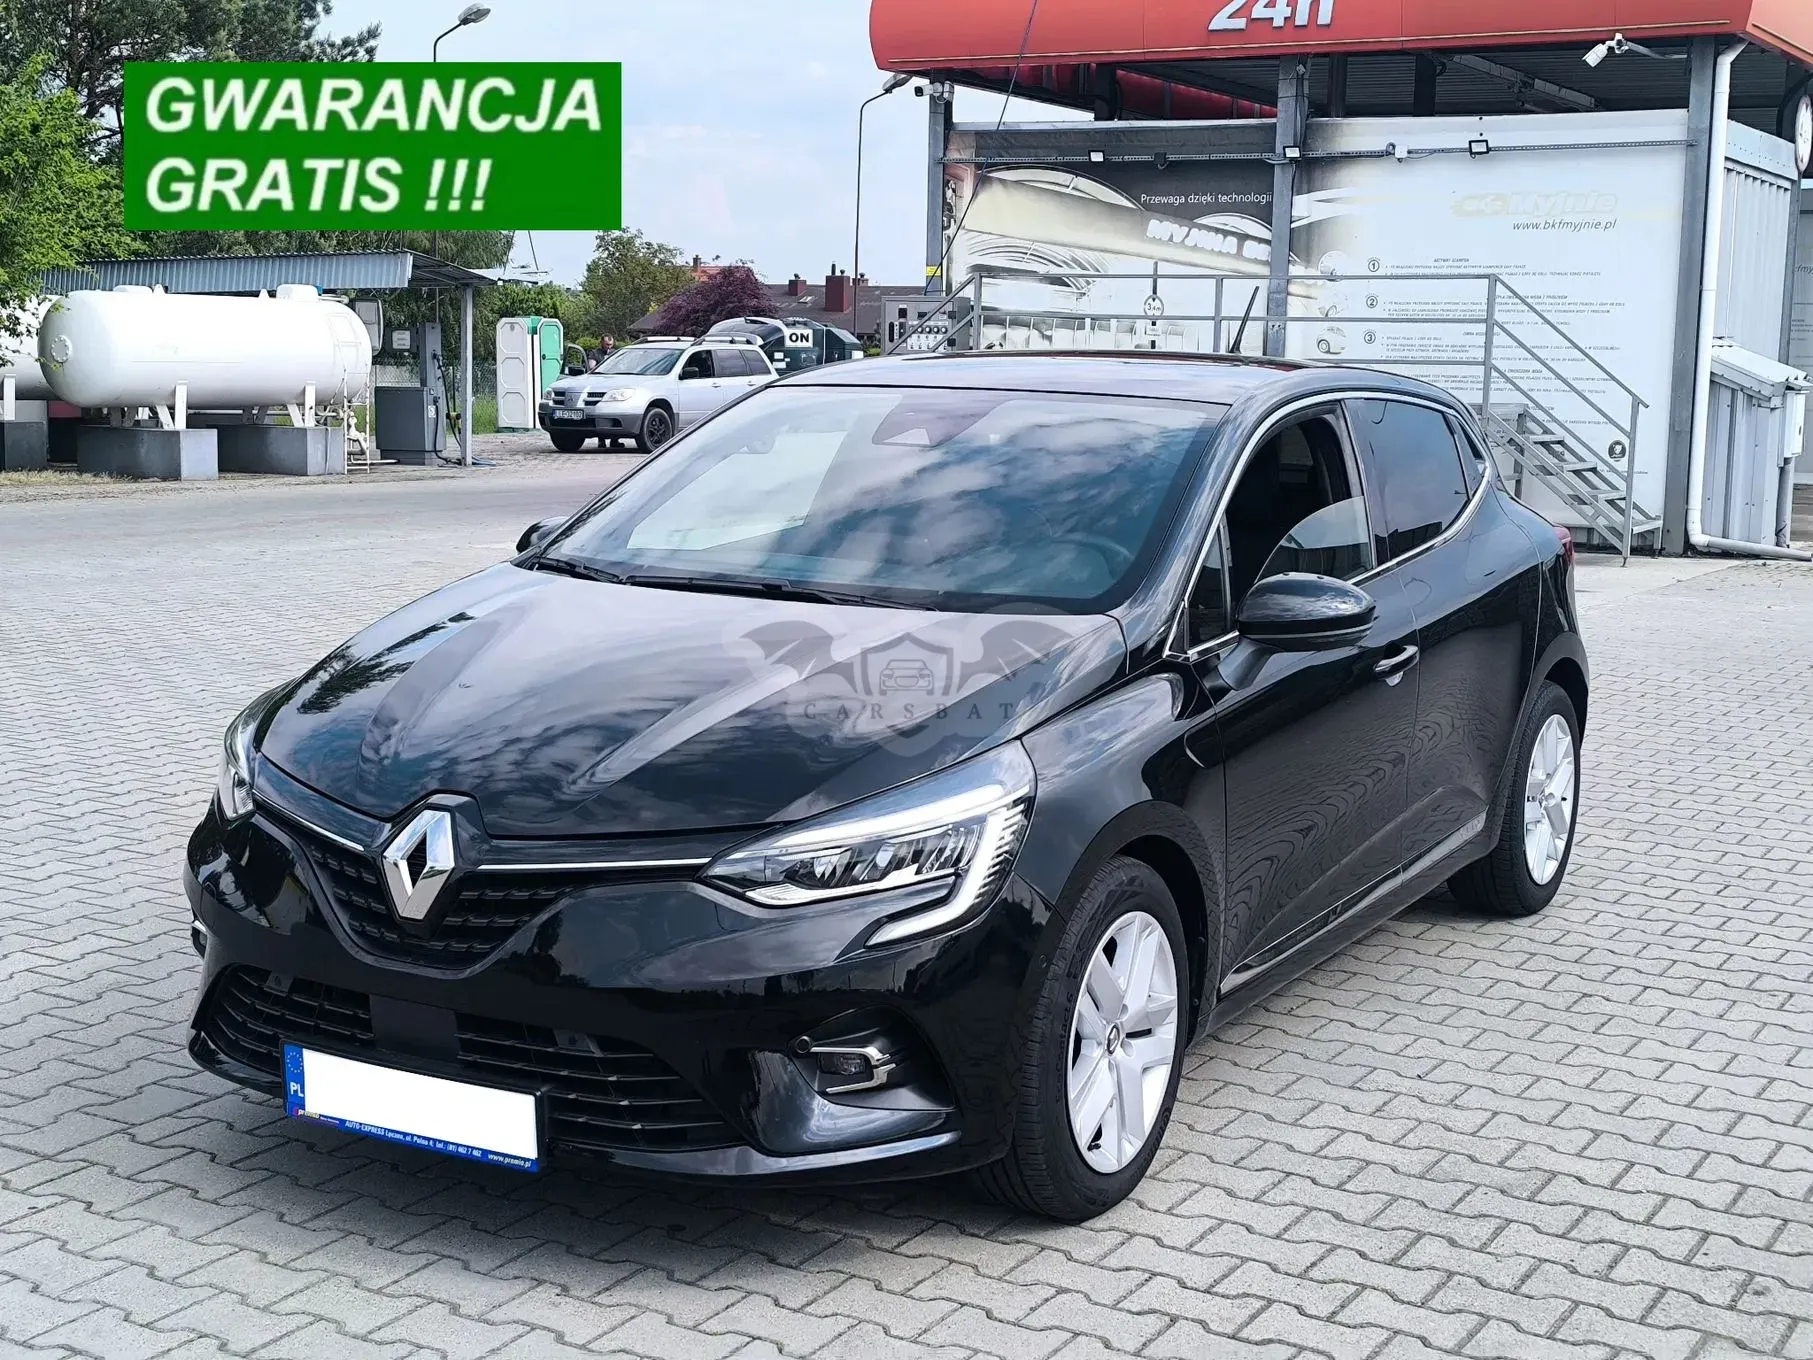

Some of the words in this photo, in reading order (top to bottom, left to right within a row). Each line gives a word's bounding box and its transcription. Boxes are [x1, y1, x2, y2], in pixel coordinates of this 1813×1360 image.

[1141, 194, 1185, 206] Przewaga
[1188, 192, 1216, 205] dzięki
[1218, 191, 1272, 204] technologii
[1512, 218, 1618, 233] www.bkfmyjnie.pl
[789, 332, 809, 343] ON
[290, 1081, 305, 1098] PL
[345, 1121, 385, 1135] AUTO-EXPRESS
[488, 1153, 532, 1168] www.premio.pl
